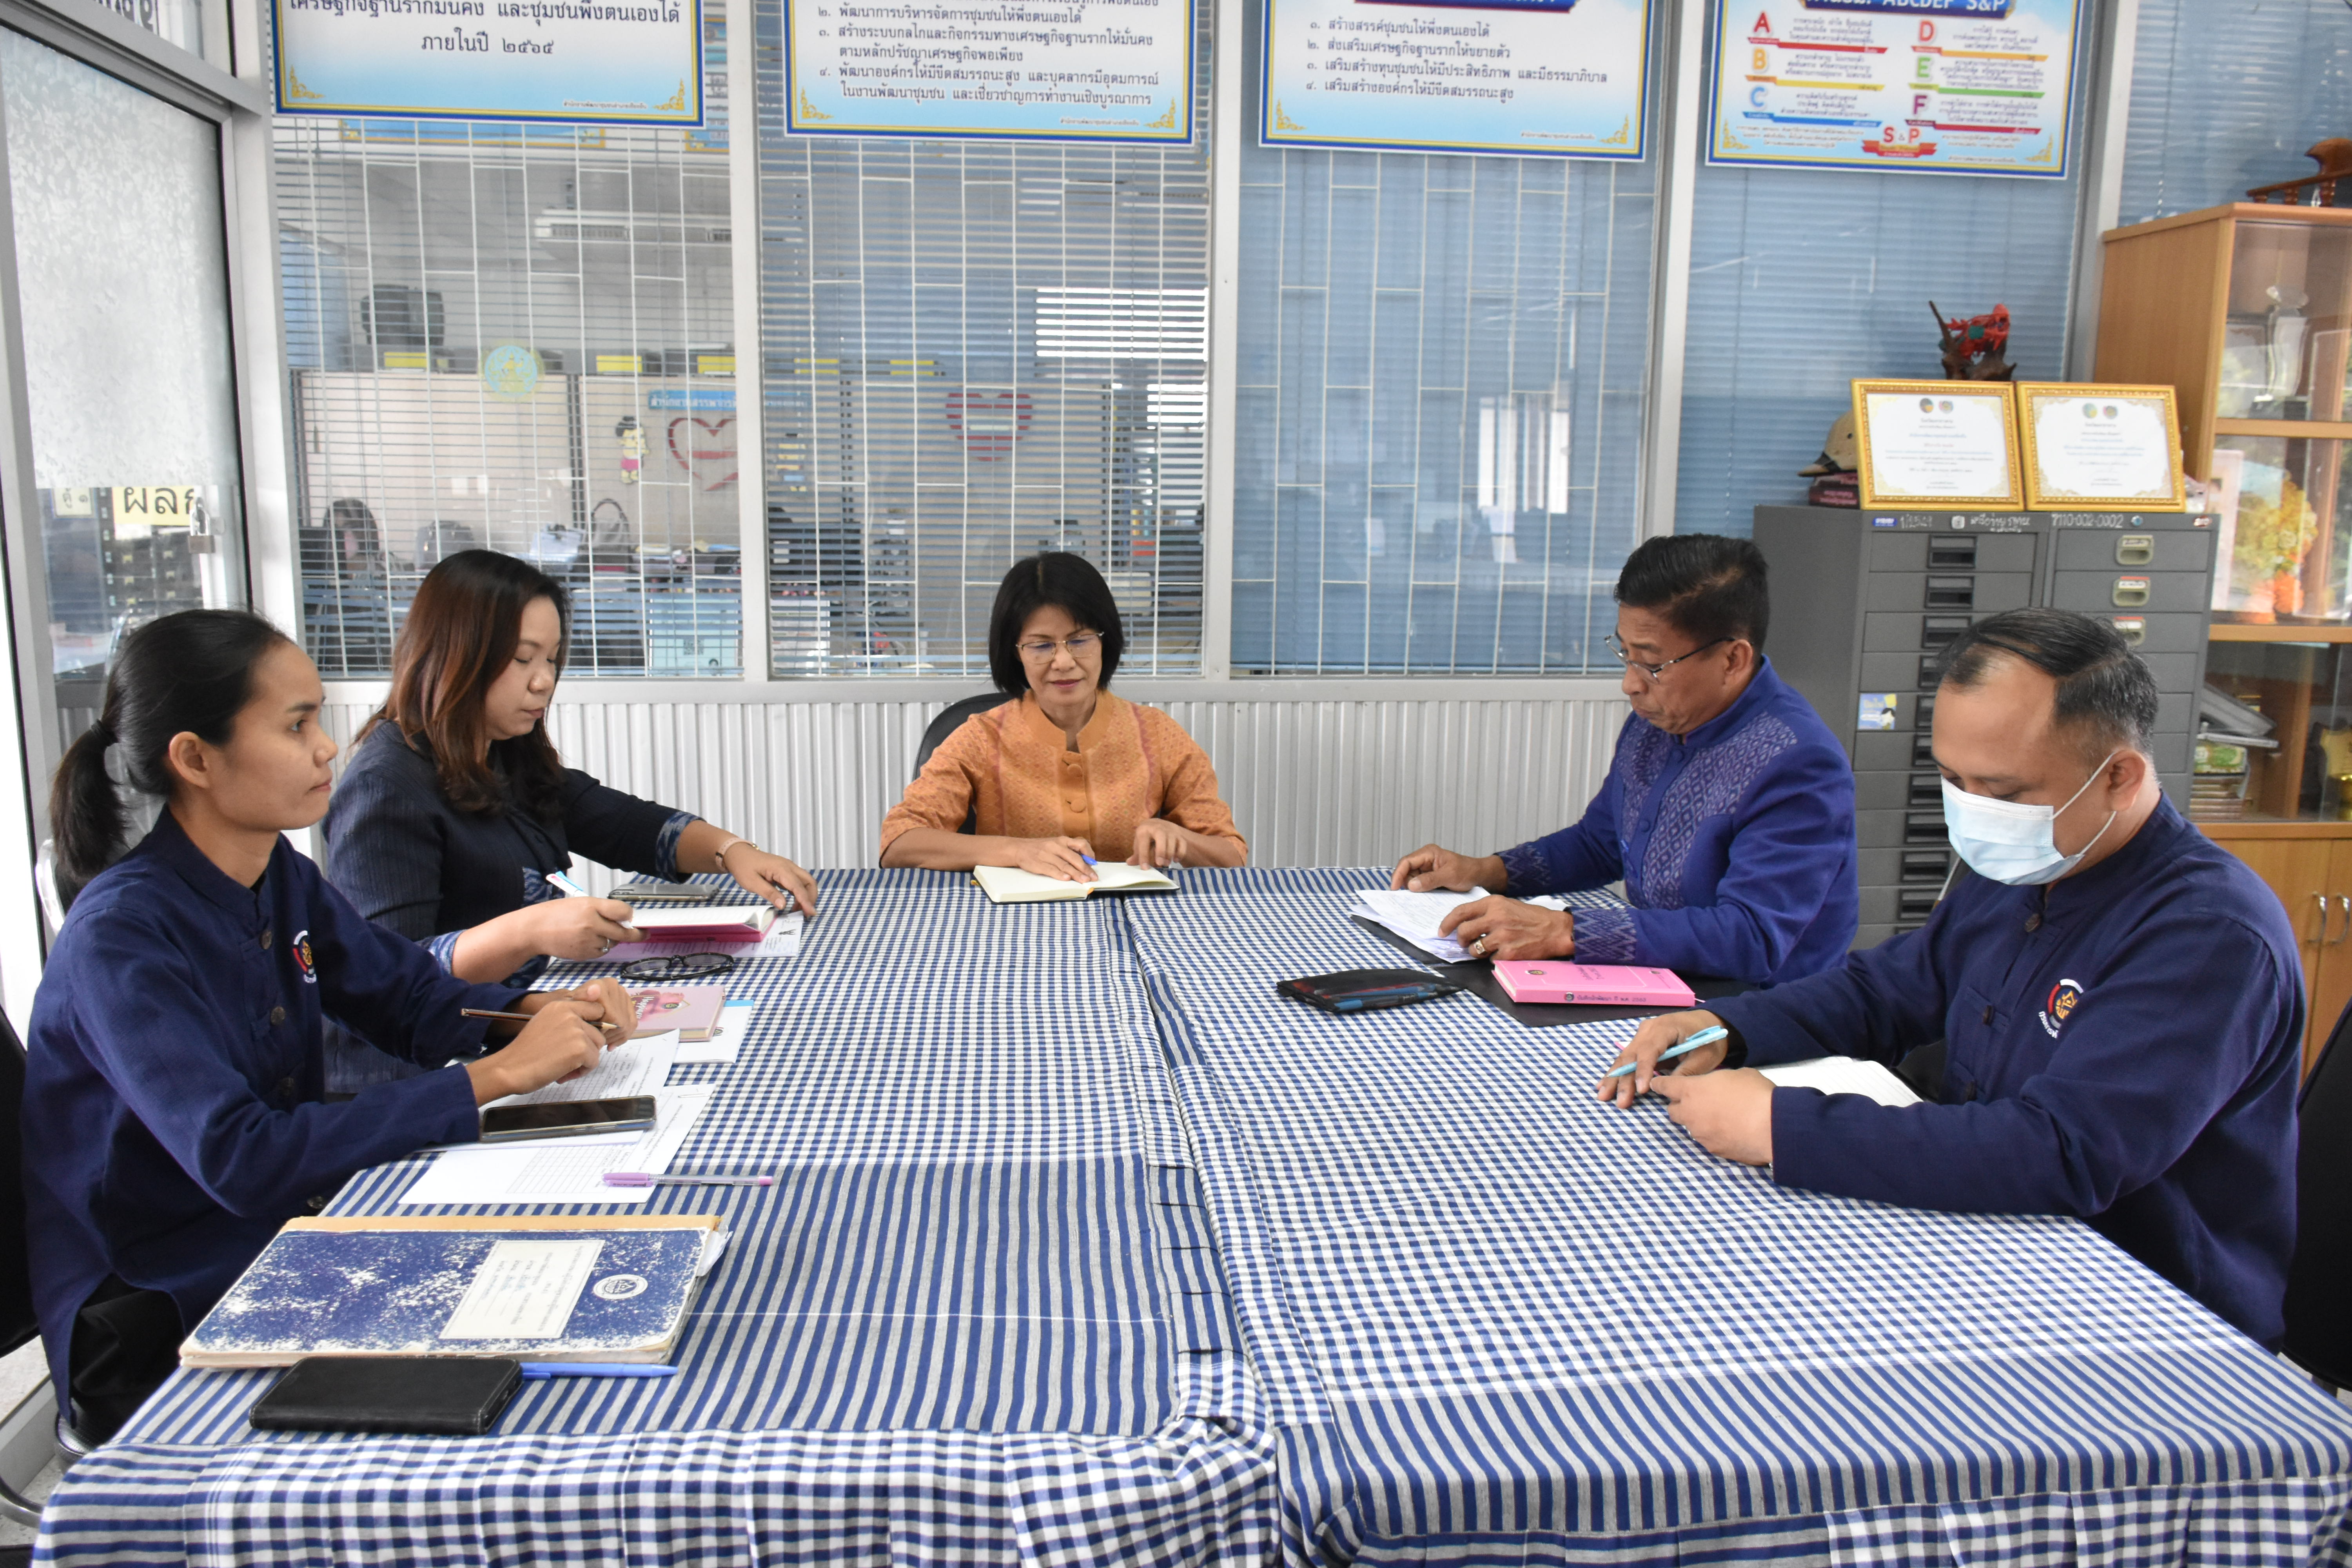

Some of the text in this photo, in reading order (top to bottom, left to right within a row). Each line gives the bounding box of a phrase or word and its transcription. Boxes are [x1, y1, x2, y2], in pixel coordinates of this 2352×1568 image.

[839, 2, 1082, 25] พัฒนาการบริหารจัดการชุมชนให้พึ่งตนเองได้
[1754, 12, 1770, 33] A
[838, 22, 1152, 46] สร้างระบบกลไกและกิจกรรมทางเศรษฐกิจฐานรากให้มั่นคง
[1329, 16, 1490, 38] สร้างสรรค์ชุมชนให้พึ่งตนเองได้
[1919, 20, 1935, 42] D
[422, 27, 554, 54] ภายในปี ๒๕๖๕
[1328, 36, 1510, 58] ส่งเสริมเศรษฐกิจฐานรากให้ขยายตัว
[840, 42, 1023, 63] ตามหลักปรัชญาเศรษฐกิจพอเพียง
[1753, 48, 1766, 70] B
[839, 59, 1020, 86] พัฒนาองค์กรให้มีขีดสมรรถนะสูง
[1029, 69, 1159, 89] และบุคลากรมีอุดมการณ์
[1326, 58, 1510, 79] เสริมสร้างทุนชุมชนให้มีประสิทธิภาพ
[1518, 66, 1607, 83] และมีธรรมาภิบาล
[1917, 57, 1931, 78] E
[840, 81, 1151, 109] ในงานพัฒนาชุมชน และเชี่ยวชาญการทำงานเชิงบูรณาการ
[1325, 78, 1514, 103] เสริมสร้างองค์กรให้มีขีดสมรรถนะสูง
[1751, 87, 1765, 107] C
[1913, 95, 1928, 114] F
[1884, 127, 1894, 143] S
[1909, 128, 1920, 143] P
